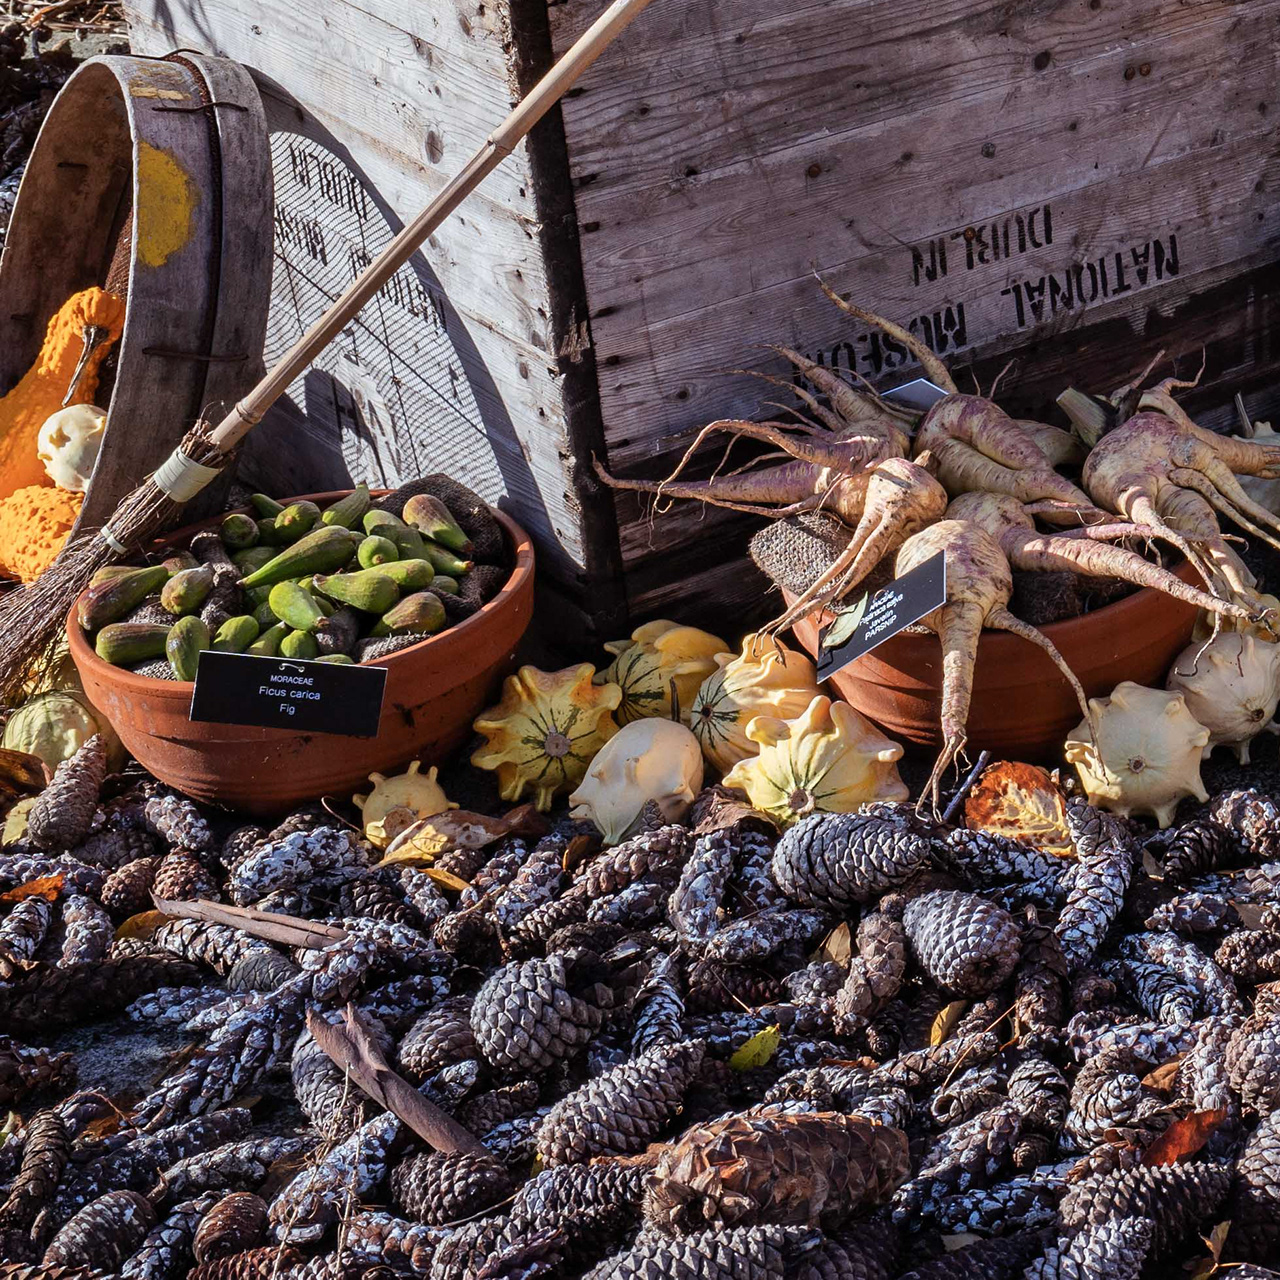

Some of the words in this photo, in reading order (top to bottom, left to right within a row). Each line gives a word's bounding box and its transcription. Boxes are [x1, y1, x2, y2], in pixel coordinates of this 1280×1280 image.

[911, 203, 1054, 287] DUBLIN
[1001, 233, 1180, 328] NATIONAL
[864, 615, 897, 641] PARSNIP
[270, 675, 314, 686] MORACEAE
[259, 686, 287, 697] Ficus
[290, 689, 321, 700] carica
[280, 703, 295, 716] Fig
